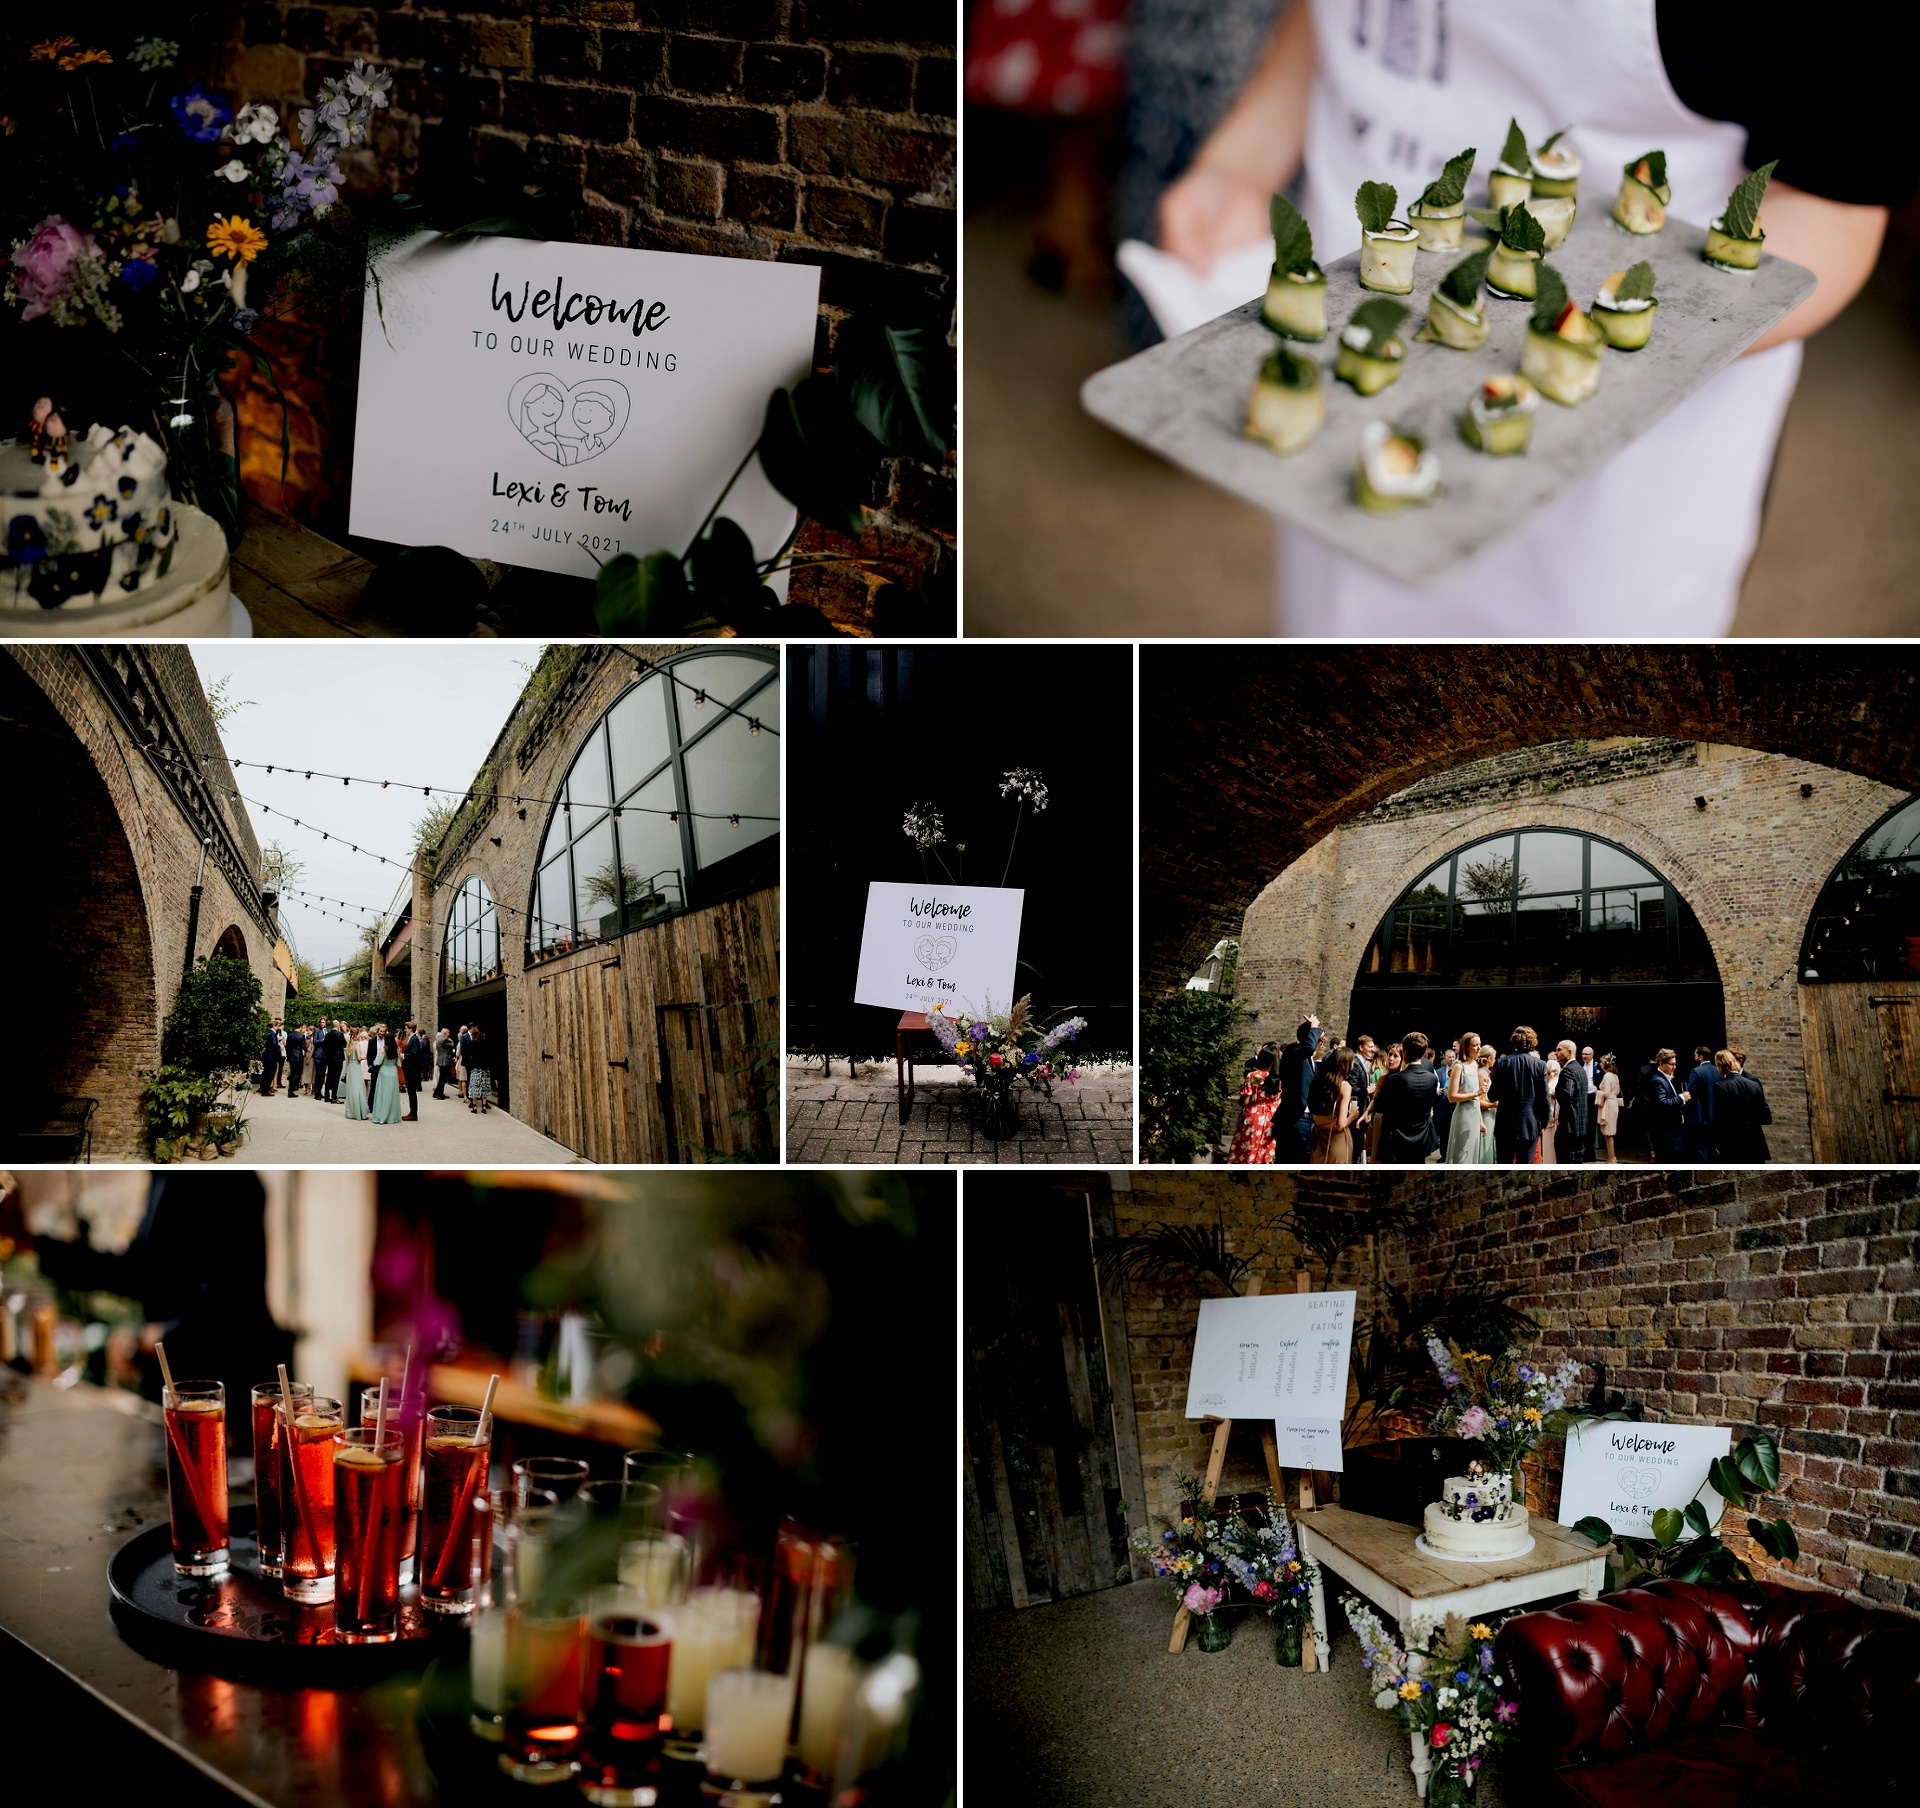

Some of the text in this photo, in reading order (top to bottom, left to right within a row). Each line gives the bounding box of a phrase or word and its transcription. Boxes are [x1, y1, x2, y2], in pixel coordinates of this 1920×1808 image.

[491, 272, 670, 336] Welcome
[472, 330, 678, 372] TO OUR WEDDING
[492, 472, 632, 521] Lexi & Tom
[491, 519, 621, 552] 24TH JULY 2021
[910, 897, 972, 919] Welcome
[903, 919, 974, 933] TO OUR WEDDING
[906, 974, 956, 992] Lexi & Tom
[937, 997, 952, 1005] 2021
[1308, 1300, 1345, 1309] SEATING
[1334, 1310, 1343, 1320] for
[1311, 1322, 1343, 1331] EATING
[1612, 1433, 1676, 1454] Welcome
[1618, 1454, 1635, 1462] OUR
[1638, 1456, 1679, 1466] WEDDING
[1610, 1501, 1655, 1516] Lexi & To
